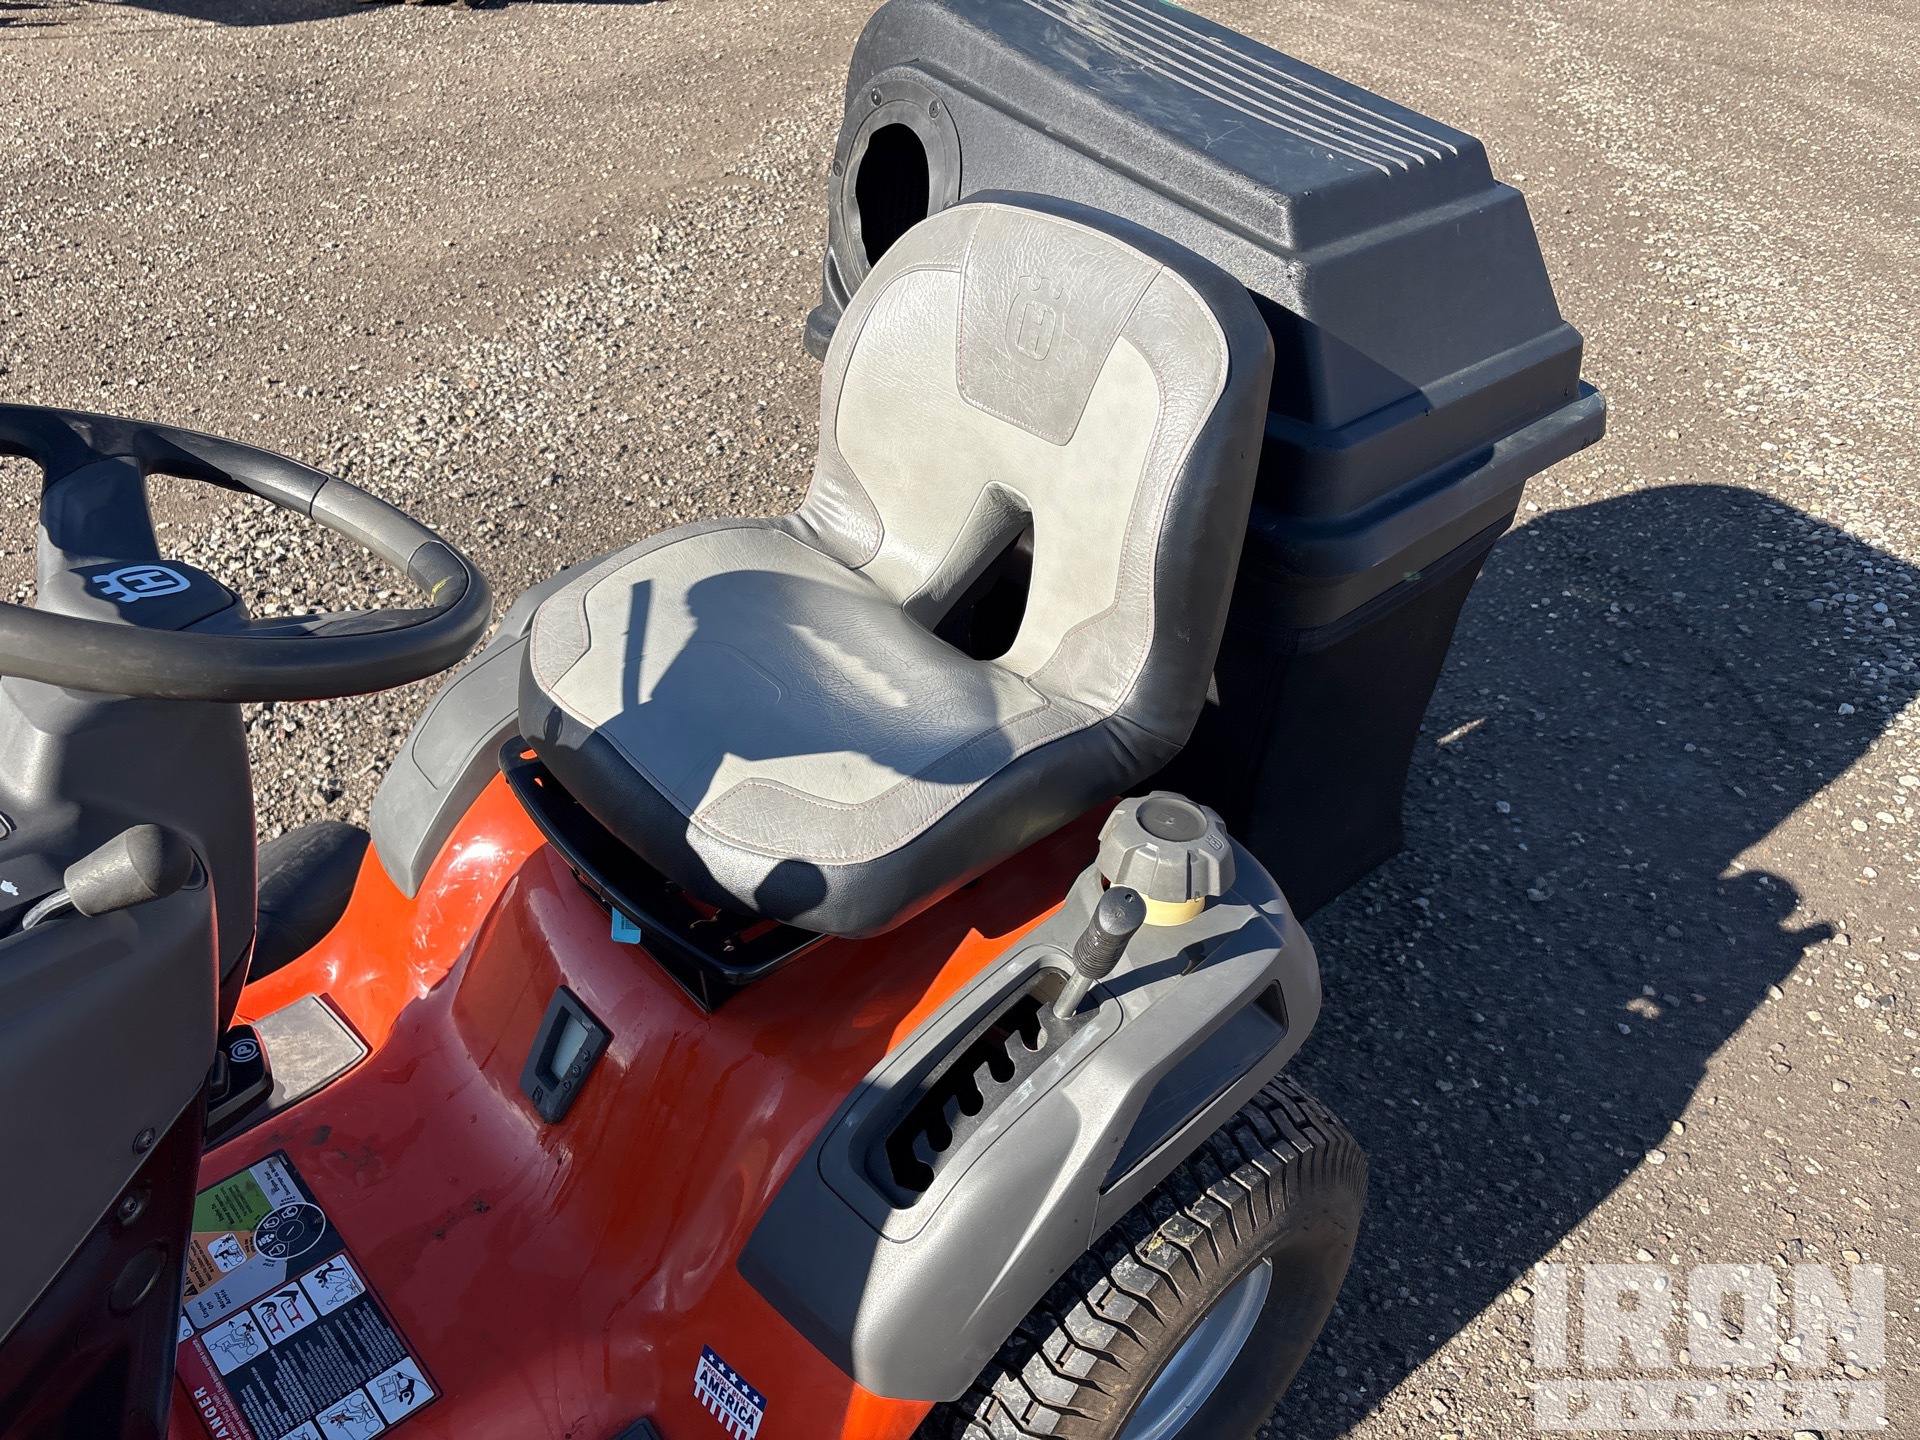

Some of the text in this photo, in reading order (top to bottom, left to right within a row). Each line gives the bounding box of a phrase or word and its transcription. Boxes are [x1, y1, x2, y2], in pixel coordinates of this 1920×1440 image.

[196, 1300, 209, 1318] Engine
[206, 1300, 214, 1309] Off
[212, 1290, 226, 1309] Moteur
[703, 1361, 732, 1391] PROUDLY
[699, 1370, 755, 1430] AMERICA
[193, 1386, 232, 1440] ANGER
